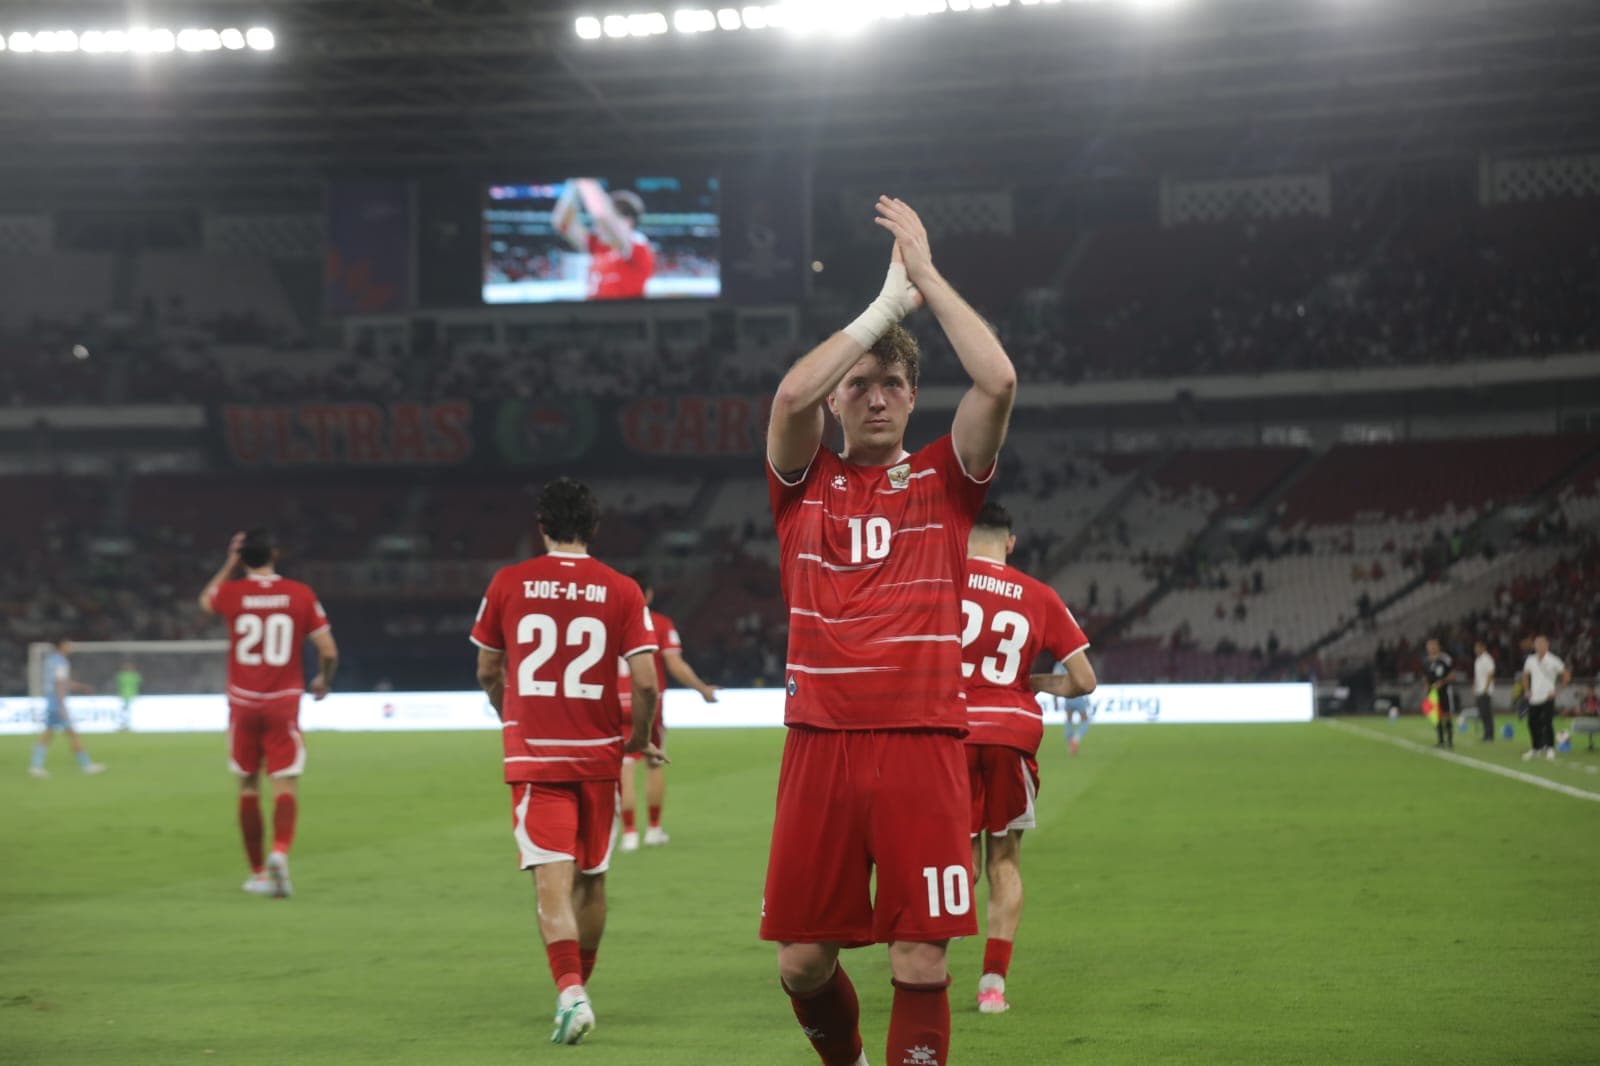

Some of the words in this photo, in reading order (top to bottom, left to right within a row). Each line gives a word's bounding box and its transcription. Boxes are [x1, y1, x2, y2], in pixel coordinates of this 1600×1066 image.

[225, 402, 472, 464] ULTRAS
[848, 517, 892, 563] 10
[523, 580, 607, 604] TJOE-A-ON
[968, 573, 1023, 600] HUBNER
[235, 613, 294, 667] 20
[516, 612, 607, 700] 22
[961, 599, 1029, 686] 23
[923, 865, 970, 917] 10
